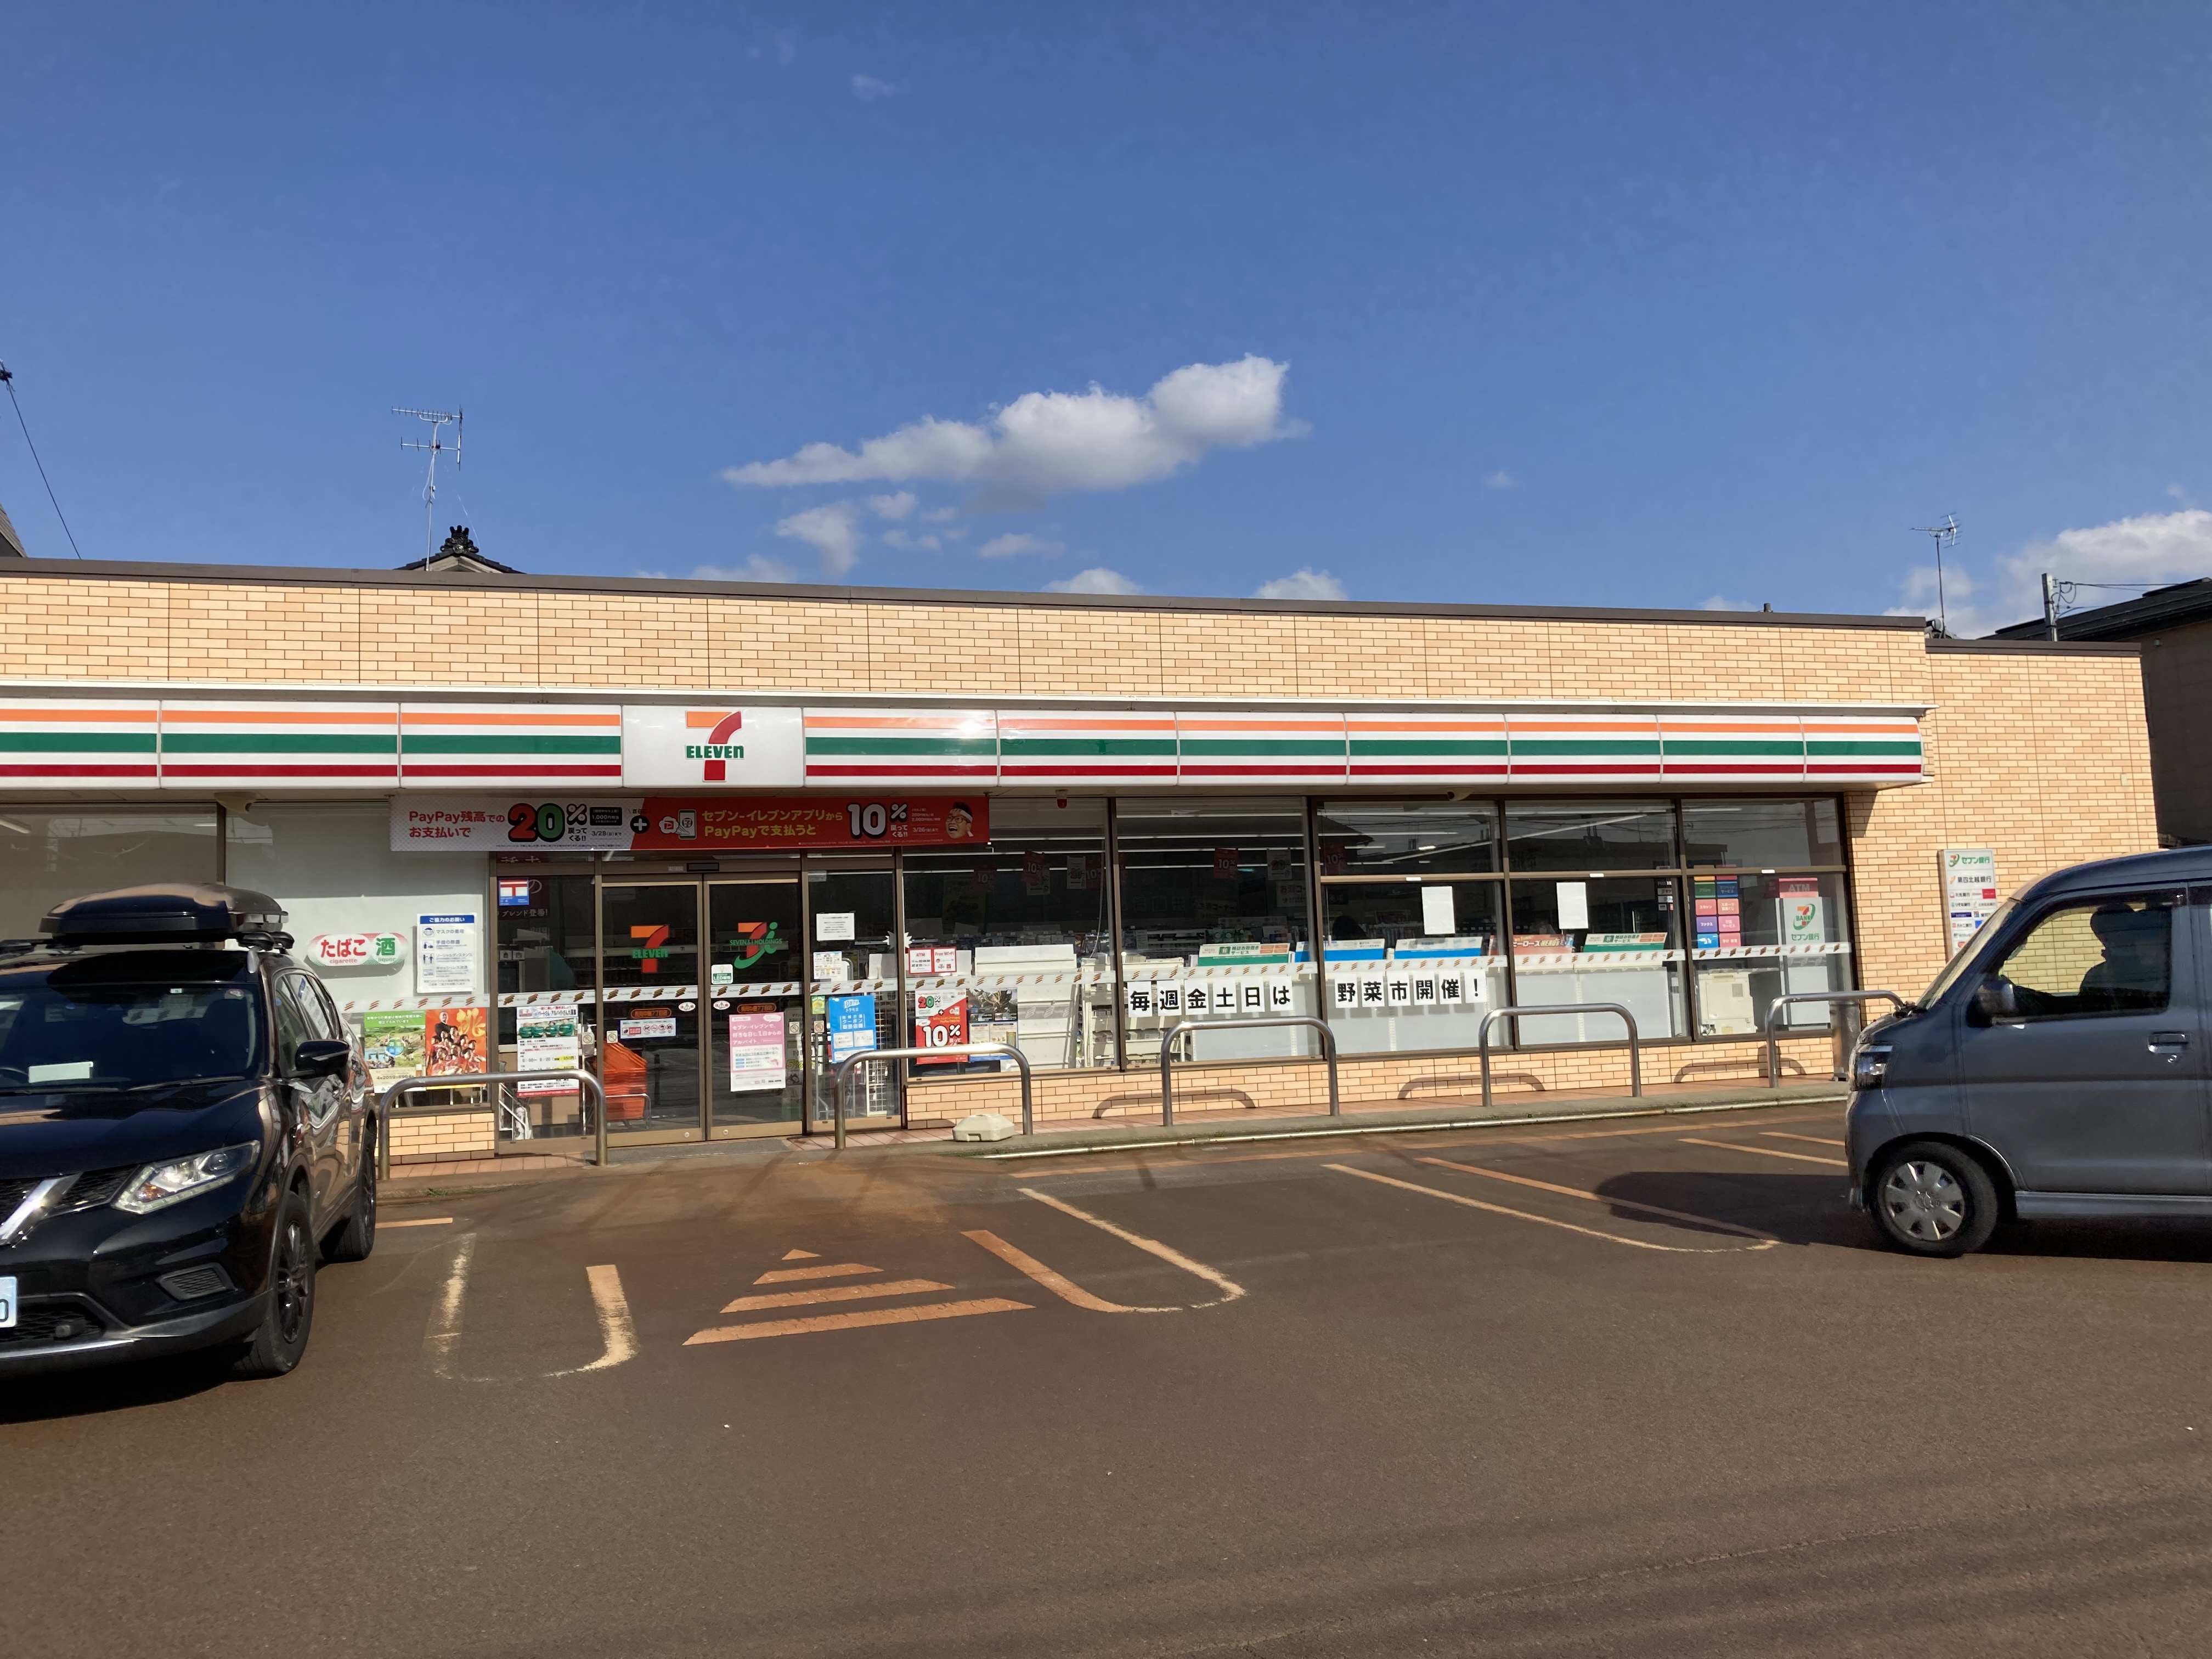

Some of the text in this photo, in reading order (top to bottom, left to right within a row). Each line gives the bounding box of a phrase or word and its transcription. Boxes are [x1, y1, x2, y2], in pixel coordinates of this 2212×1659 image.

[409, 811, 505, 824] PayPay残高での
[409, 827, 471, 838] お支払いで
[704, 825, 817, 839] PayPayで支払うと
[1962, 856, 1990, 865] セブン銀行
[1788, 884, 1810, 892] ATM
[321, 938, 366, 958] たばこ
[376, 938, 396, 956] 酒
[1130, 985, 1290, 1012] 毎週金土日は
